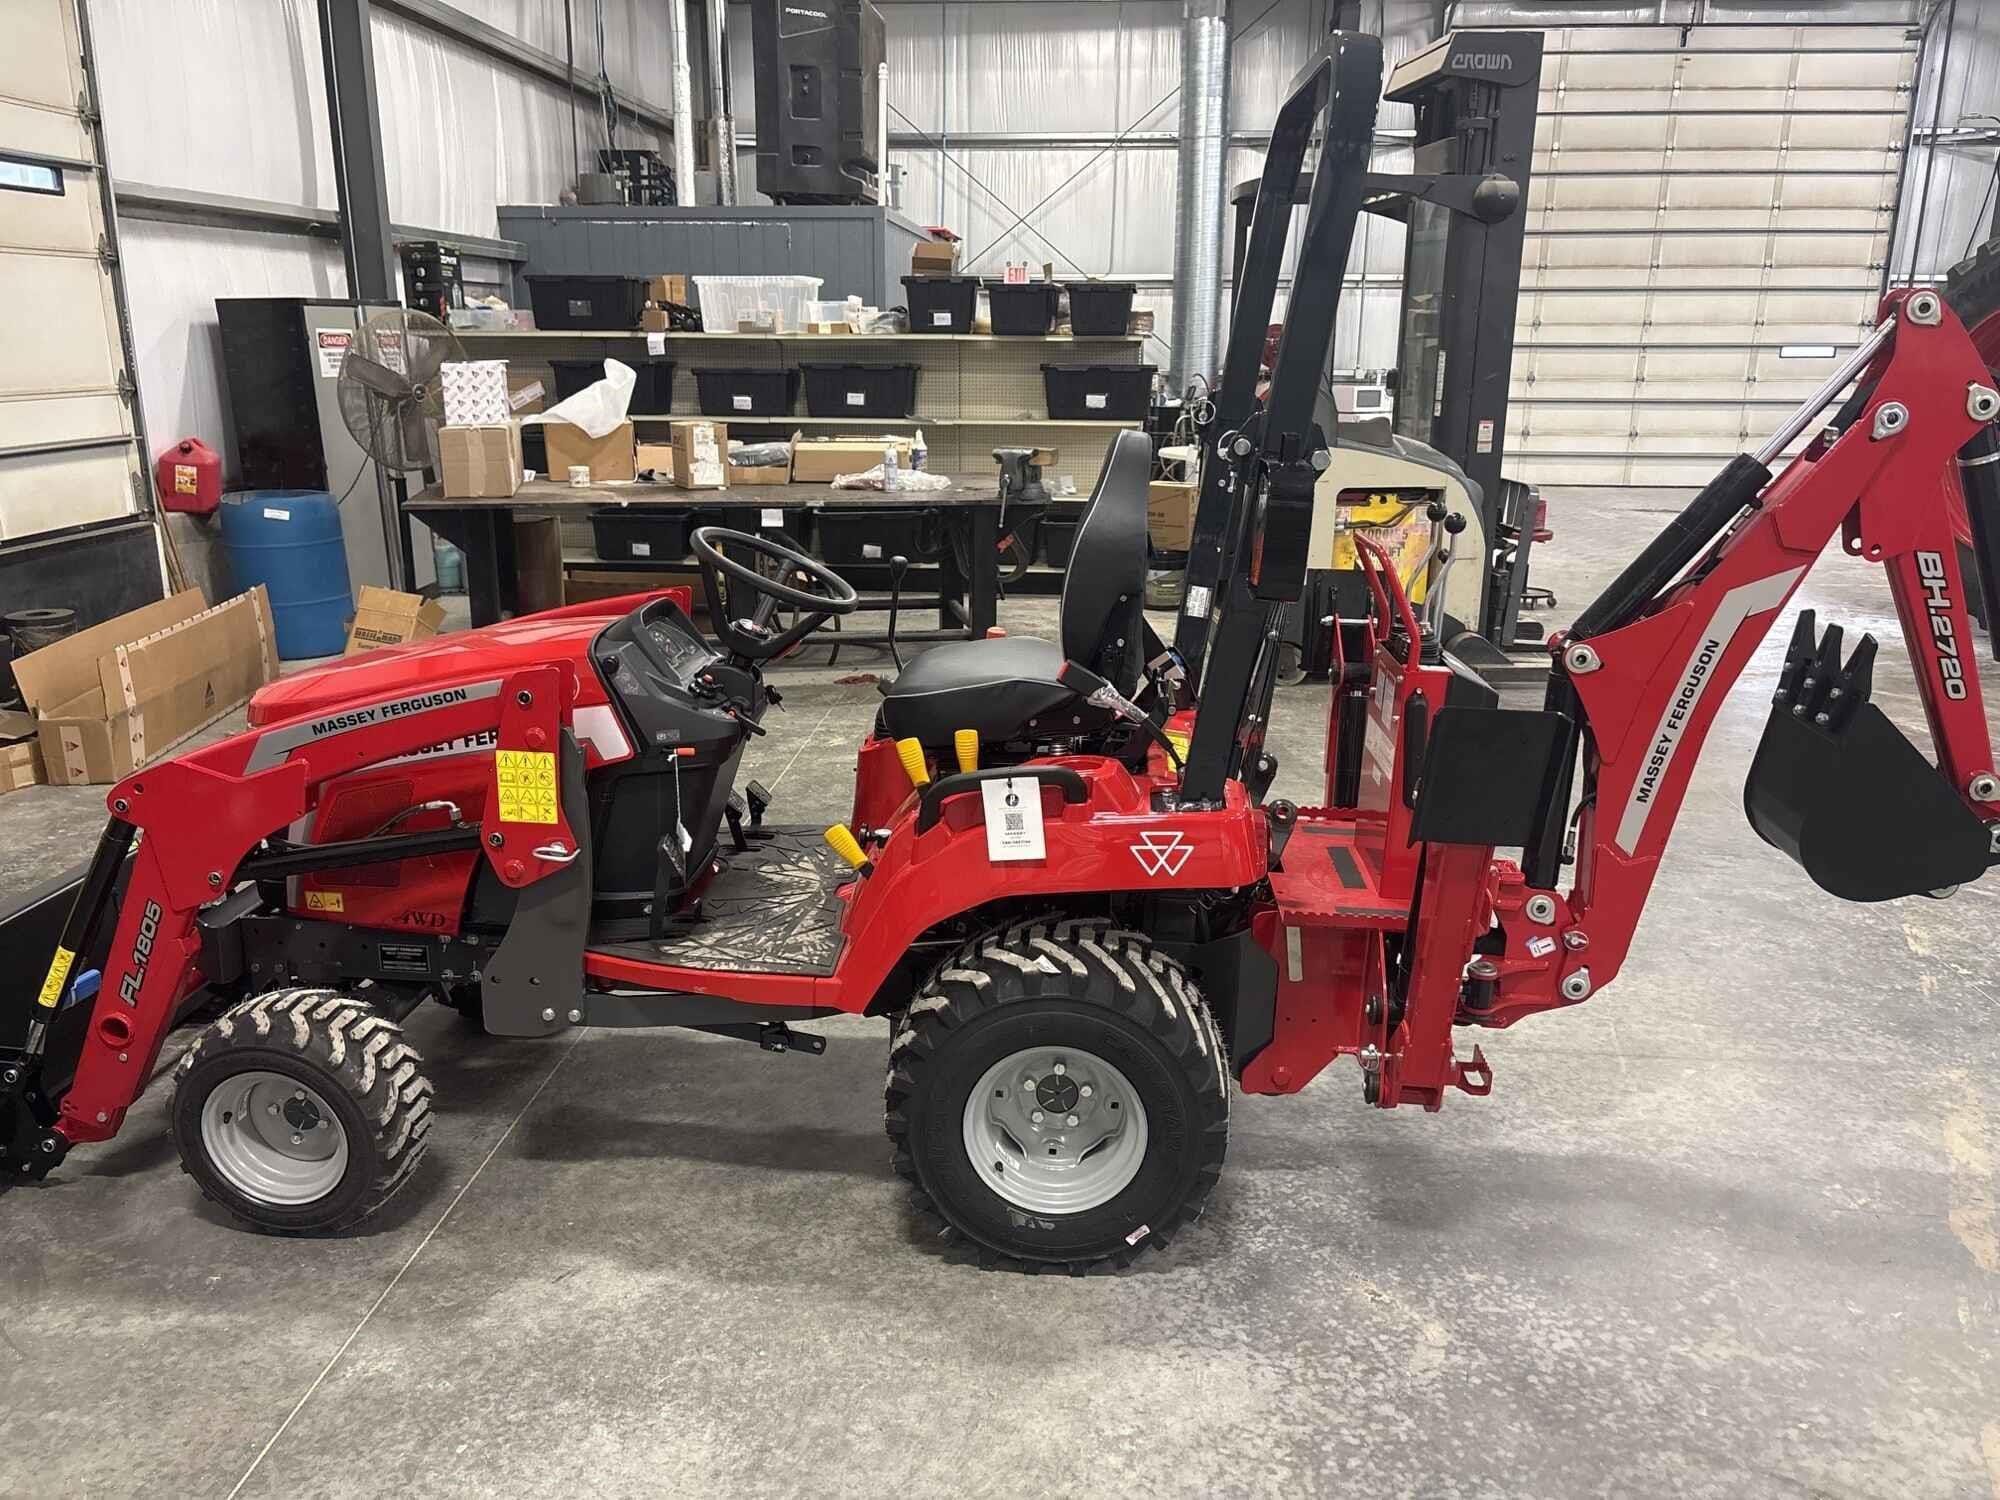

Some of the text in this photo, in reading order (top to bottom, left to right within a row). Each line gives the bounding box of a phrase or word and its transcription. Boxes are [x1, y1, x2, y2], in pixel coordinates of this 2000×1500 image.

[785, 7, 828, 18] PORTACOOL
[1008, 267, 1025, 282] EXIT
[322, 335, 349, 346] DANGER
[1915, 551, 1967, 700] BH.2720
[312, 688, 467, 736] MASSEY FERGUSON
[1635, 639, 1720, 803] MASSEY FERGUSON
[399, 910, 446, 928] 4WD
[119, 898, 163, 1007] FL.1805
